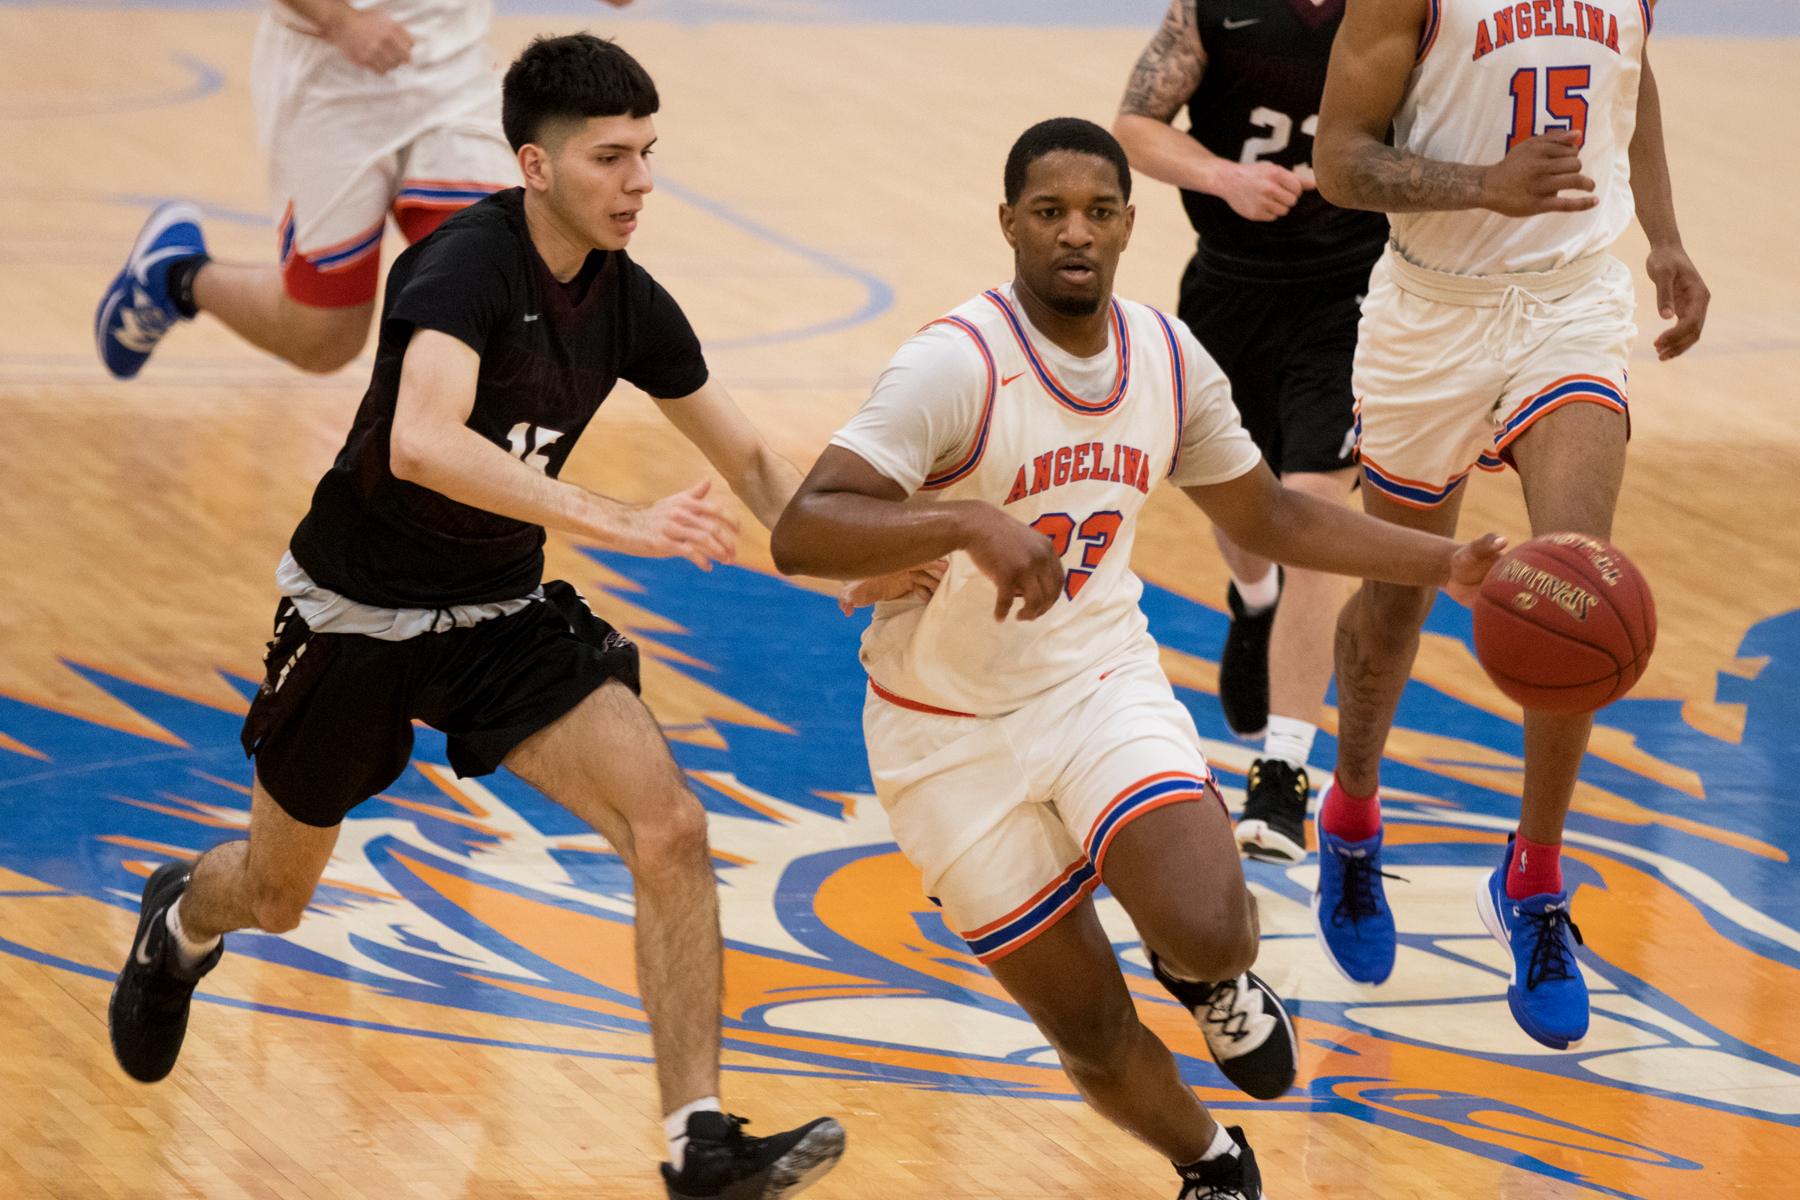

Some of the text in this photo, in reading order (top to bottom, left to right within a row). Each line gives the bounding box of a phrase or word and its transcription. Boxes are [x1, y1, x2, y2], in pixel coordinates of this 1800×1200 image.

[1472, 0, 1621, 62] ANGELINA
[1505, 65, 1591, 155] 15
[1003, 442, 1149, 507] ANGELINA
